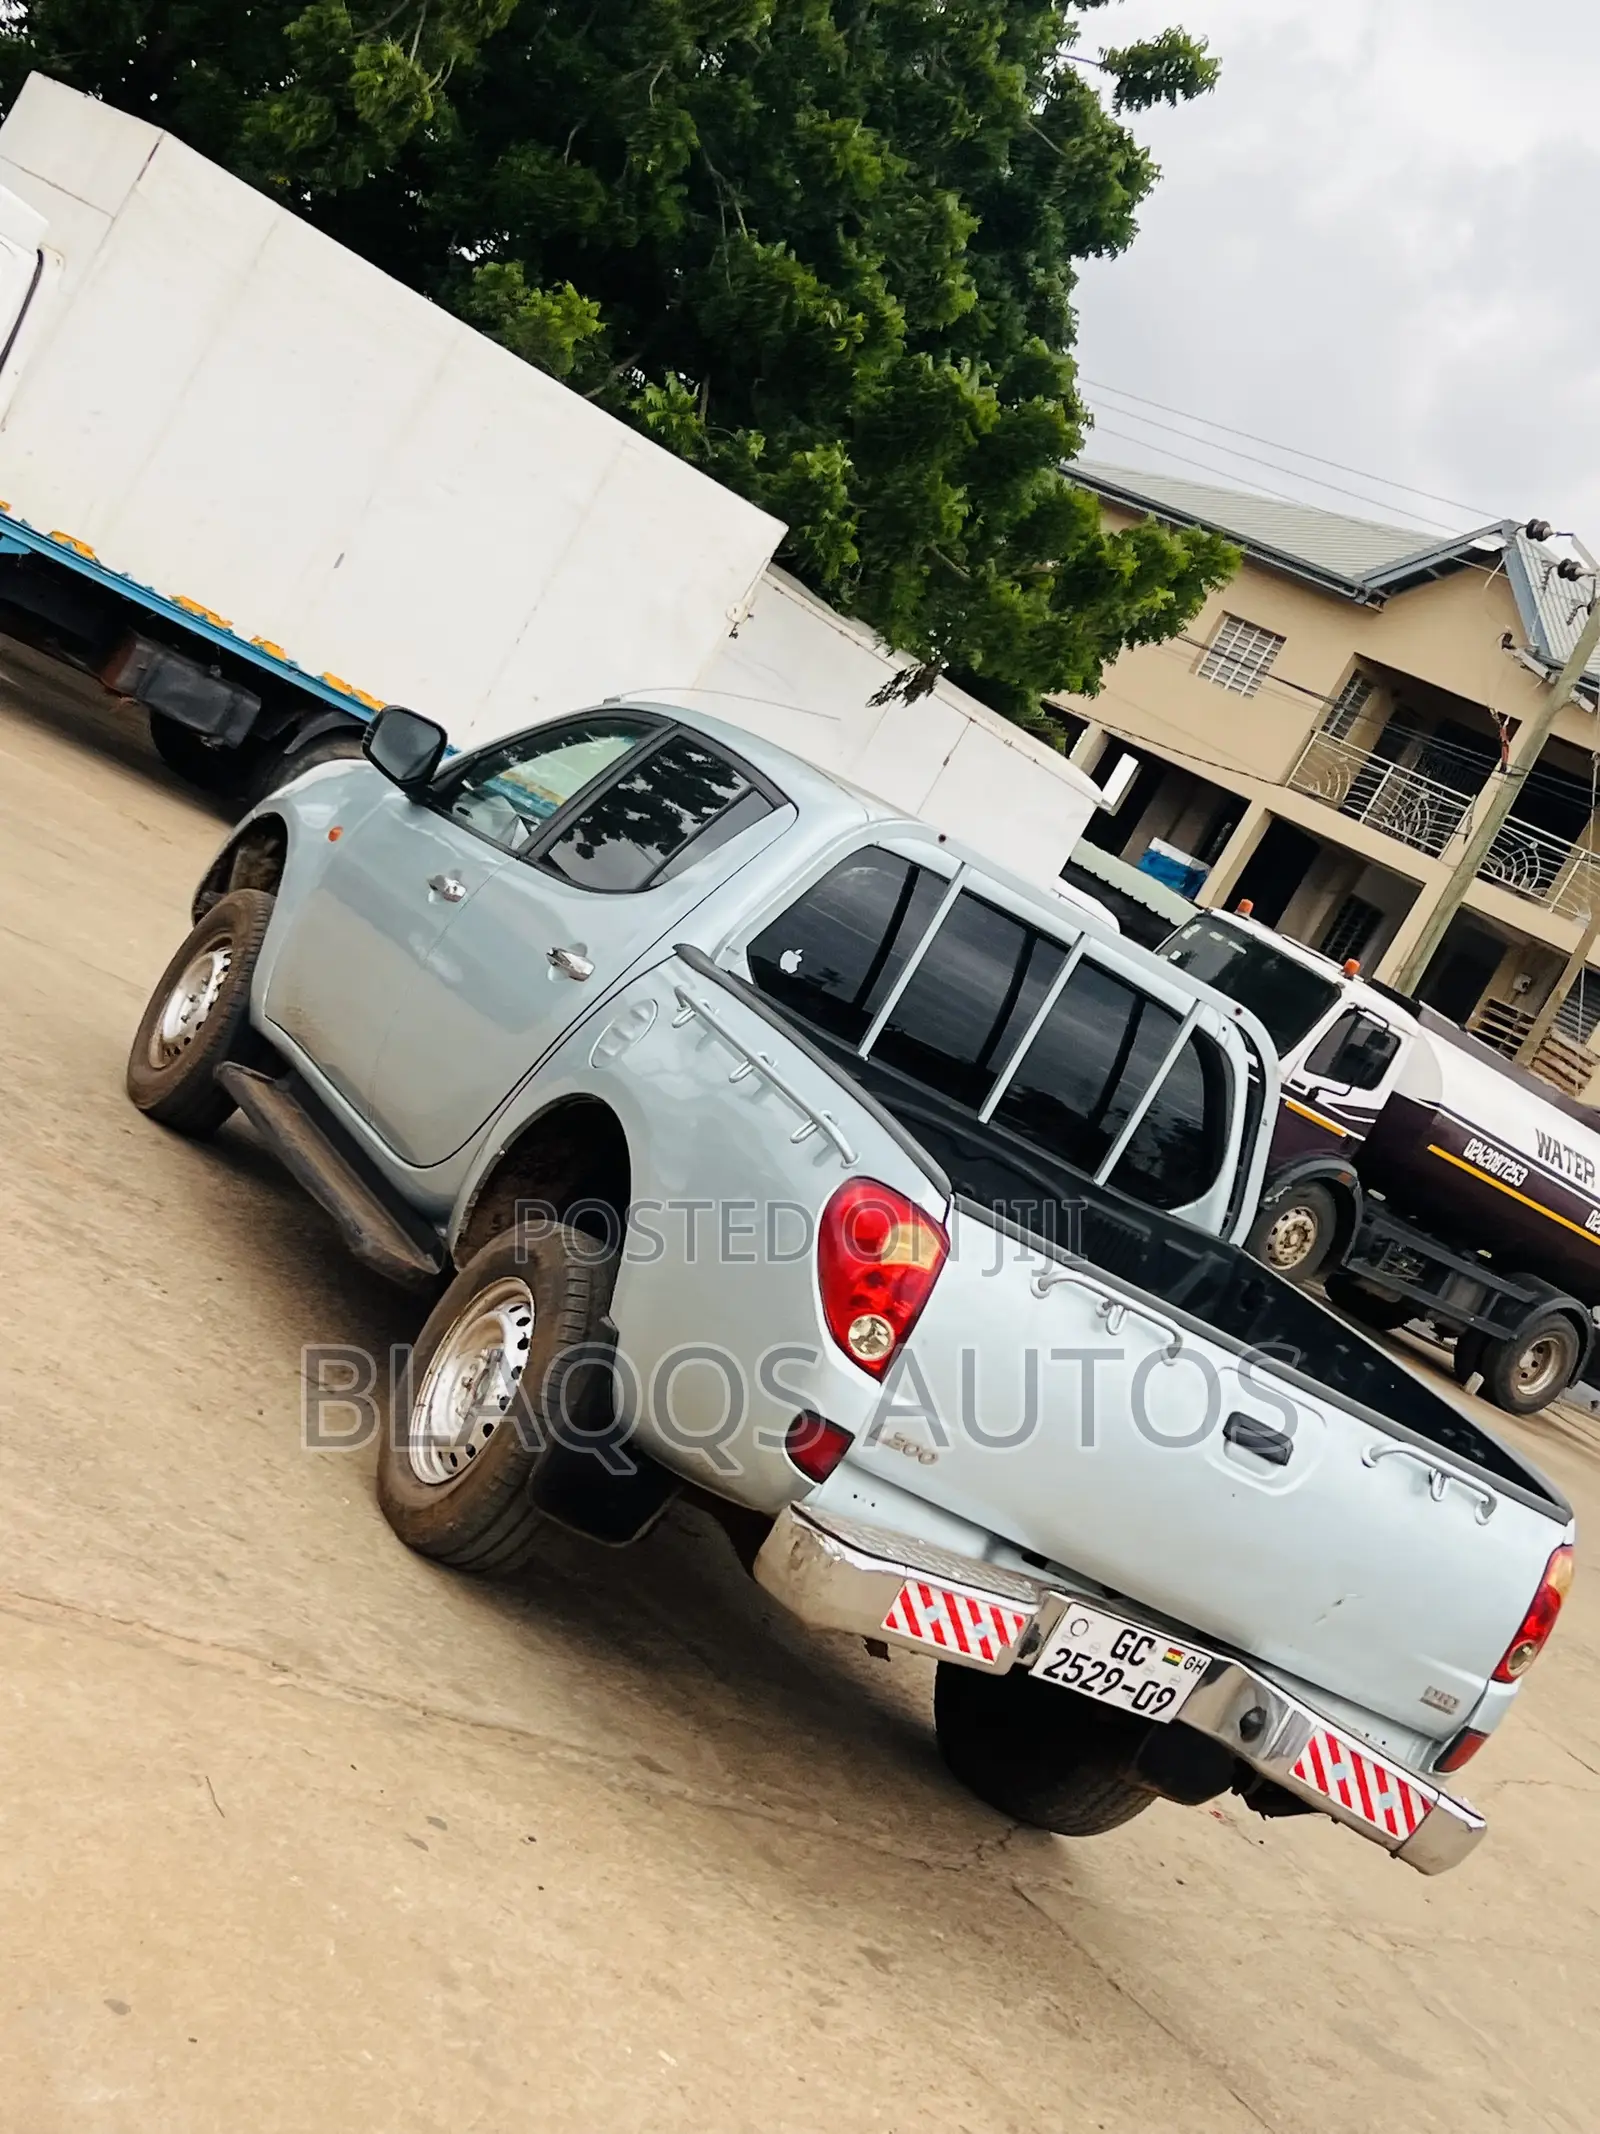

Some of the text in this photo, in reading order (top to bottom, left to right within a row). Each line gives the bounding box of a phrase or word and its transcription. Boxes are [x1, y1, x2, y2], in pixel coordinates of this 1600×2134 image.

[1535, 1128, 1595, 1188] WATER
[1042, 1647, 1177, 1715] 2529-09
[1110, 1629, 1207, 1675] GC GH
